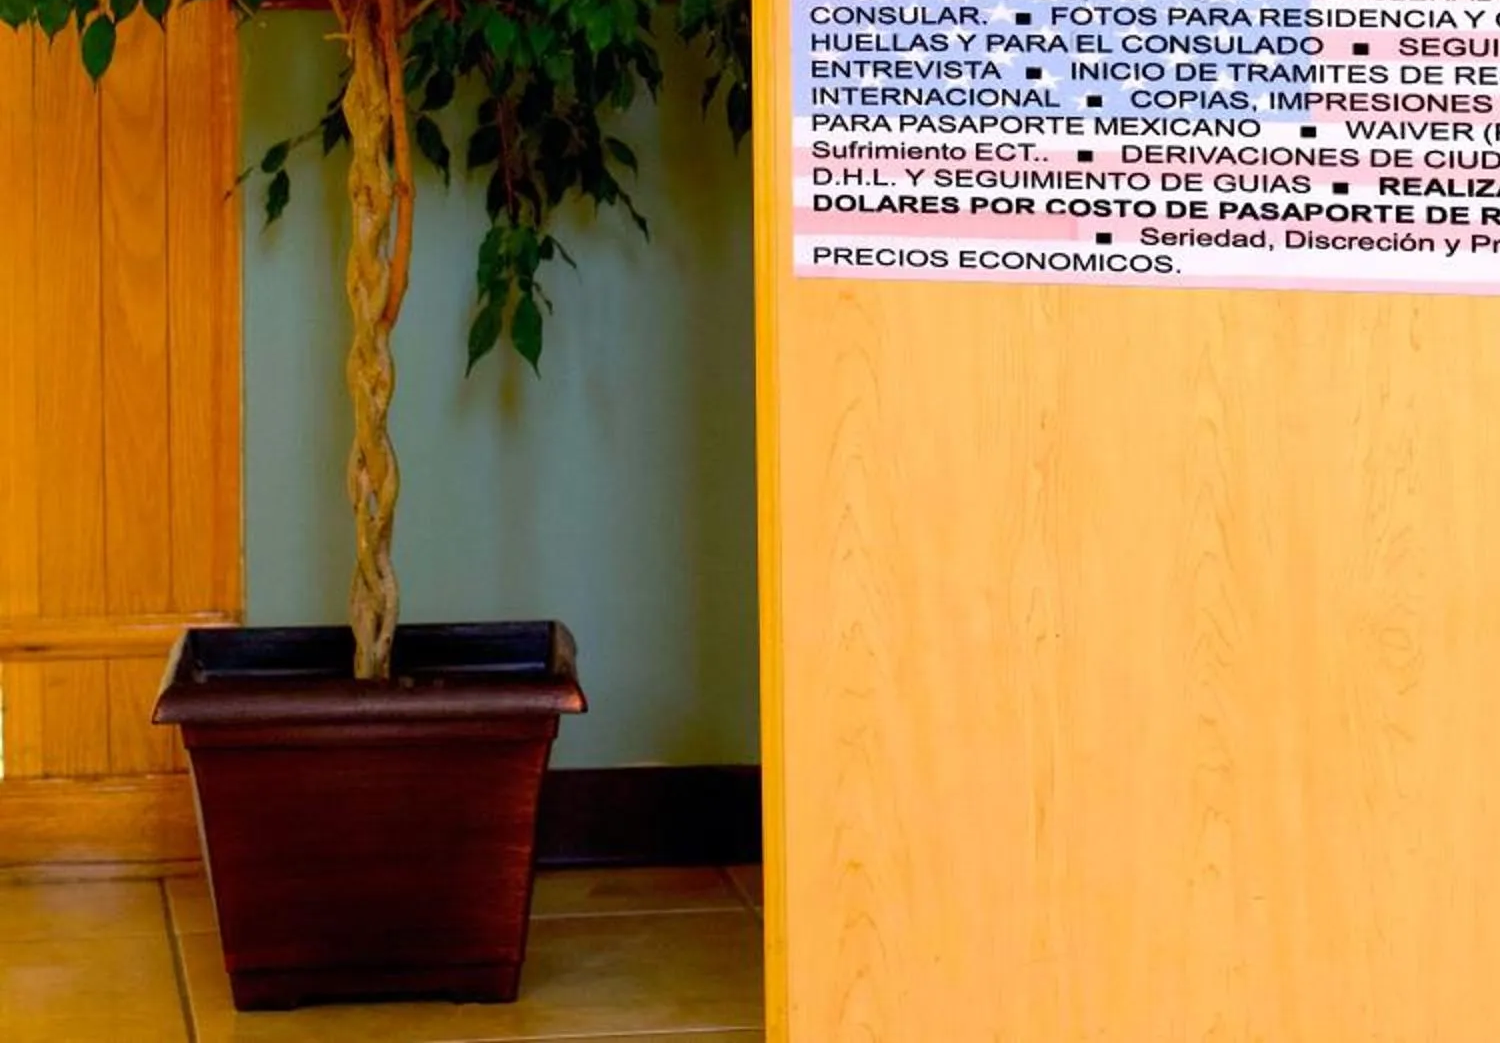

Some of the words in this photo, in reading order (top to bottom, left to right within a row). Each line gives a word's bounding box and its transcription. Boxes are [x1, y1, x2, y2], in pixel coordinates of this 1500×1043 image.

[809, 6, 988, 26] CONSULAR.
[1051, 6, 1158, 27] FOTOS
[1167, 7, 1253, 28] PARA
[1259, 8, 1458, 29] RESIDENCIA
[1463, 10, 1486, 29] Y
[811, 32, 949, 52] HUELLAS
[956, 33, 977, 53] Y
[985, 33, 1069, 54] PARA
[1076, 34, 1113, 54] EL
[1121, 34, 1324, 56] CONSULADO
[811, 60, 1003, 80] ENTREVISTA
[1071, 61, 1165, 82] INICIO
[1175, 62, 1218, 82] DE
[1226, 62, 1389, 84] TRAMITES
[1400, 65, 1443, 85] DE
[811, 86, 1061, 108] INTERNACIONAL
[1130, 89, 1257, 113] COPIAS,
[1269, 91, 1493, 114] IMPRESIONES
[812, 113, 893, 132] PARA
[899, 114, 1085, 136] PASAPORTE
[1094, 116, 1261, 138] MEXICANO
[1345, 120, 1474, 142] WAIVER
[811, 140, 967, 161] Sufrimiento
[975, 142, 1048, 162] ECT..
[1121, 144, 1360, 168] DERIVACIONES
[1370, 148, 1414, 168] DE
[813, 167, 896, 186] D.H.L.
[905, 168, 925, 187] Y
[934, 168, 1151, 191] SEGUIMIENTO
[1161, 172, 1203, 192] DE
[1213, 173, 1311, 194] GUIAS
[813, 194, 961, 215] DOLARES
[970, 196, 1035, 215] POR
[1045, 198, 1157, 219] COSTO
[1165, 200, 1209, 220] DE
[1219, 201, 1415, 224] PASAPORTE
[1426, 205, 1471, 226] DE
[1140, 226, 1274, 252] Seriedad,
[1285, 229, 1435, 252] Discreción
[1444, 238, 1461, 258] y
[813, 246, 949, 268] PRECIOS
[959, 250, 1181, 274] ECONOMICOS.
